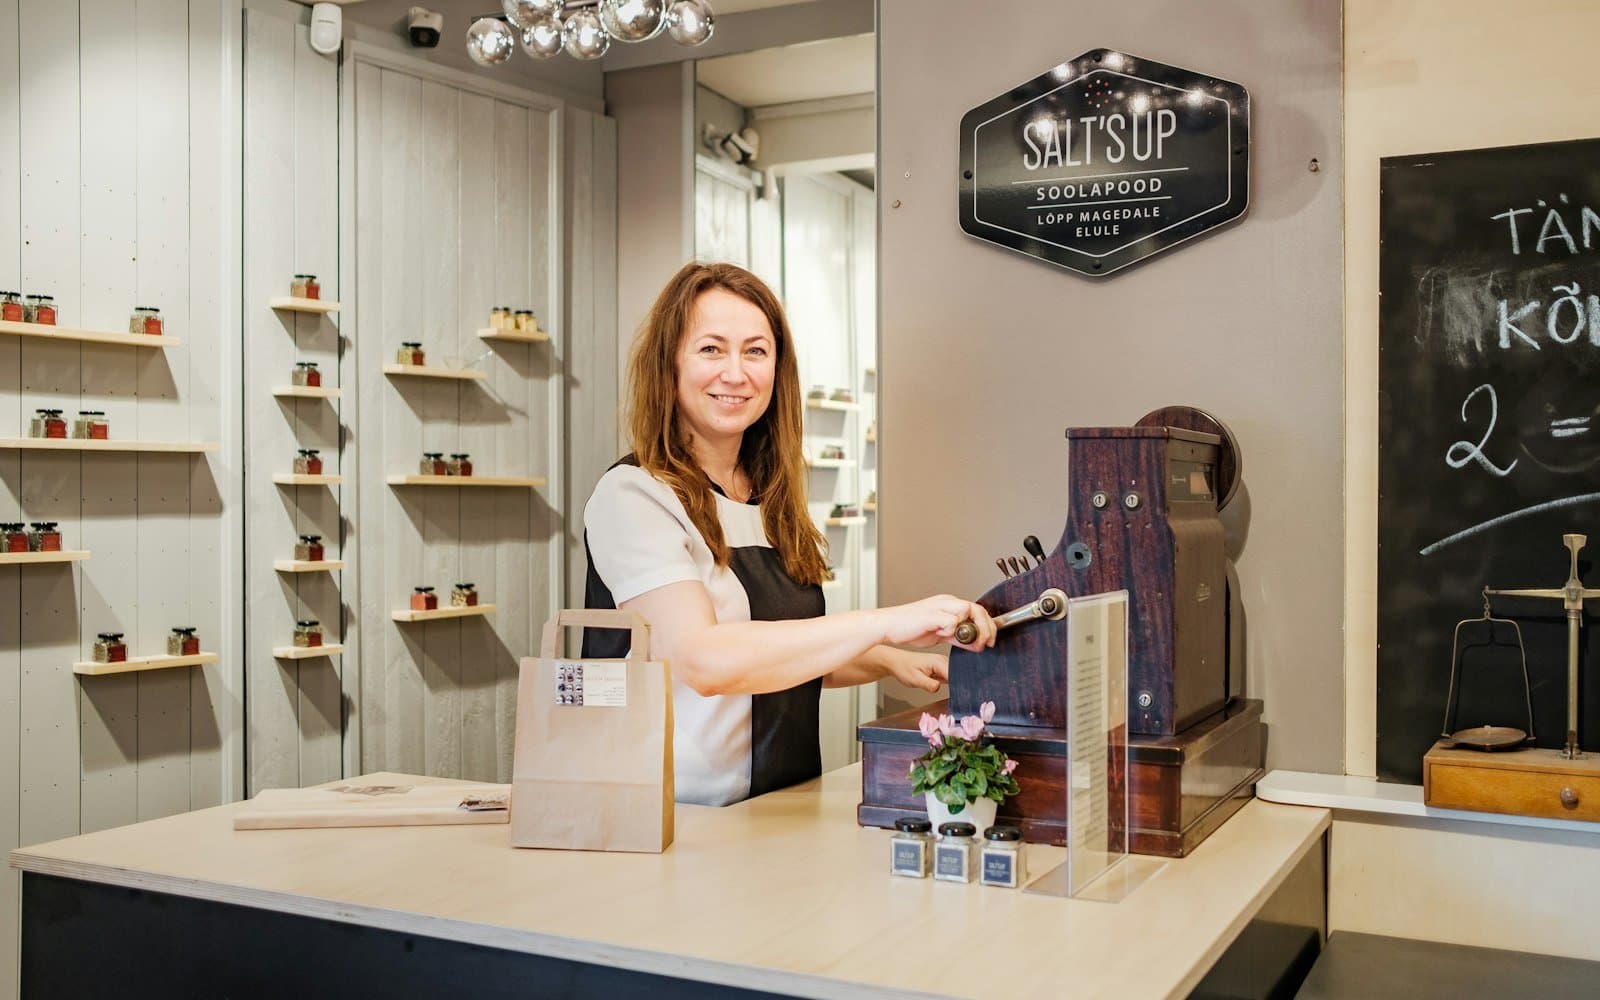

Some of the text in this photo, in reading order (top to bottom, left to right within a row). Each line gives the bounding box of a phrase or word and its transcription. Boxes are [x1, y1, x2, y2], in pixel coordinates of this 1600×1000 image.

[1036, 177, 1163, 201] SOOLAPOOD
[1079, 206, 1161, 223] MAGEDALE
[1075, 224, 1120, 238] ELULE
[1445, 383, 1518, 477] 2
